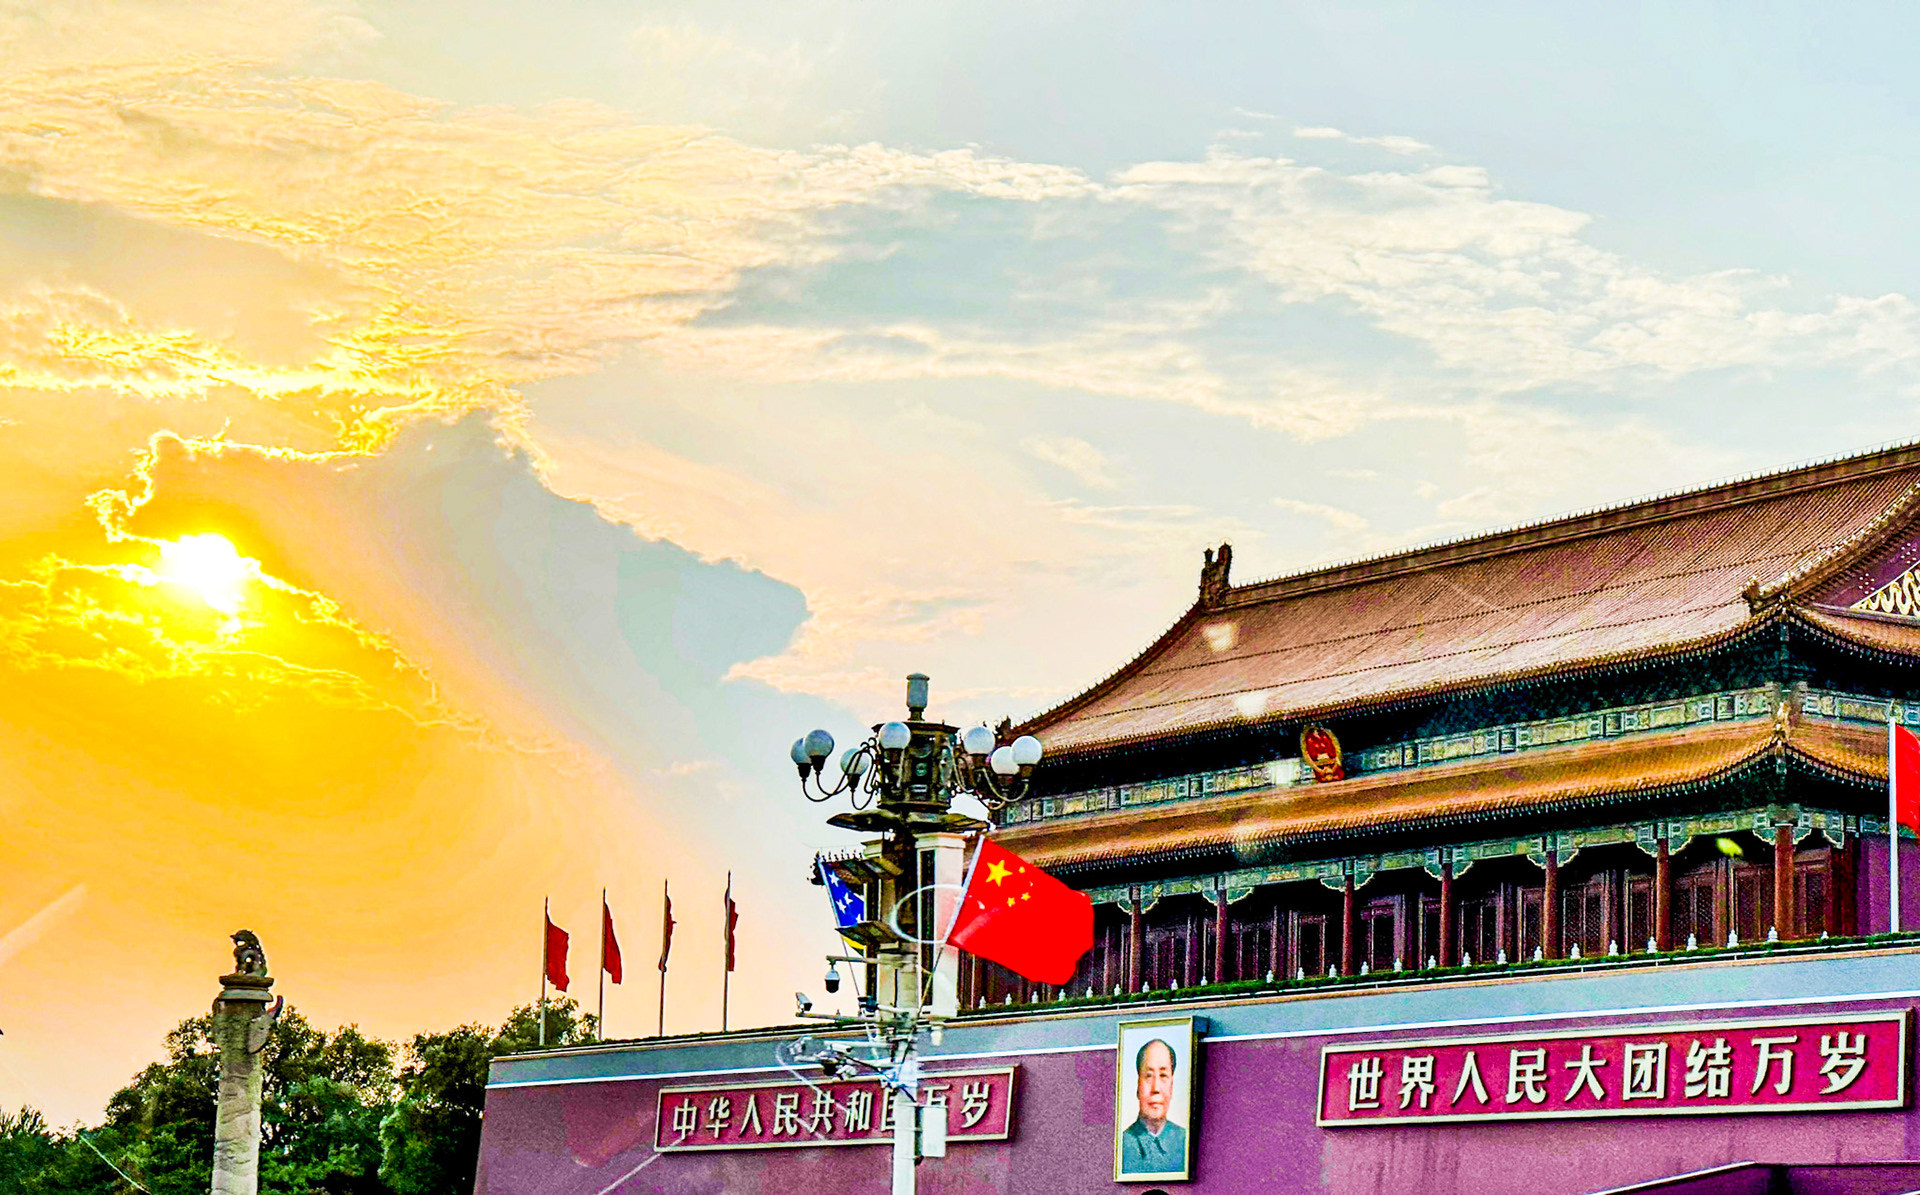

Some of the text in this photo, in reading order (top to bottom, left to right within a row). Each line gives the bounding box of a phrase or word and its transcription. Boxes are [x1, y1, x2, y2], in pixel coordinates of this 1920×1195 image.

[1347, 1031, 1867, 1110] 世界人民大团结万岁
